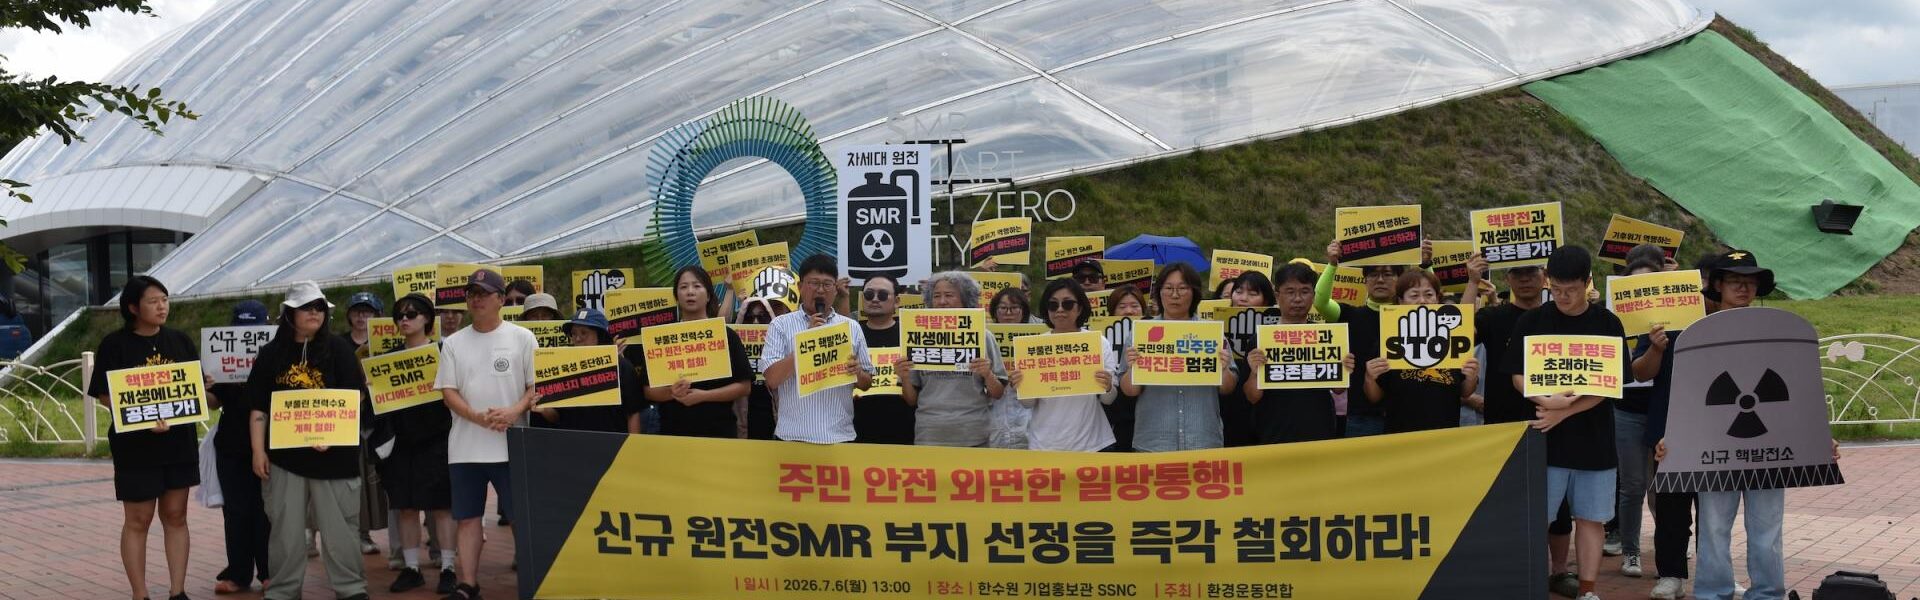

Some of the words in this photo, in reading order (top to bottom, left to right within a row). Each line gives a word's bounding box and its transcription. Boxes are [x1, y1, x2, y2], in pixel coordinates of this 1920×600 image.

[847, 151, 887, 167] 차세대
[892, 150, 919, 165] 원전
[972, 189, 1075, 223] ZERO
[856, 207, 901, 225] SMR
[1487, 209, 1546, 227] 핵발전과
[1343, 224, 1375, 236] 기후위기
[1377, 216, 1410, 229] 역행하는
[1480, 224, 1554, 244] 재생에너지
[1342, 239, 1376, 254] 원전확대
[1379, 231, 1417, 247] 중단하라!
[1612, 231, 1641, 241] 기후위기
[1643, 234, 1672, 245] 역행하는
[702, 246, 718, 257] 신규
[719, 238, 754, 252] 핵발전소
[1485, 241, 1553, 262] 공존불가!
[397, 273, 413, 284] 신규
[446, 276, 459, 285] 신규
[1614, 290, 1631, 301] 지역
[1633, 286, 1660, 298] 불평등
[1662, 283, 1698, 295] 초래하는
[610, 303, 637, 317] 기후위기
[639, 298, 669, 311] 역행하는
[1615, 300, 1654, 314] 핵발전소
[1656, 297, 1676, 308] 그만
[1677, 295, 1700, 307] 짓자!
[372, 324, 395, 336] 지역
[915, 315, 972, 330] 핵발전과
[209, 331, 237, 354] 신규
[654, 333, 678, 345] 부풀린
[680, 329, 714, 342] 전력수요
[800, 339, 816, 354] 신규
[818, 332, 848, 349] 핵발전소
[907, 331, 979, 346] 재생에너지
[1273, 329, 1333, 345] 핵발전과
[647, 348, 662, 359] 신규
[708, 339, 725, 351] 건설
[911, 347, 976, 364] 공존불가!
[1027, 346, 1053, 356] 부풀린
[1055, 343, 1089, 354] 전력수요
[1137, 343, 1175, 354] 국민의힘
[1176, 339, 1218, 354] 민주당
[1265, 346, 1341, 362] 재생에너지
[1385, 335, 1471, 360] STOP
[1531, 343, 1563, 356] 지역
[1568, 343, 1616, 359] 불평등
[370, 364, 391, 377] 신규
[393, 354, 436, 371] 핵발전소
[536, 364, 559, 378] 핵산업
[561, 361, 577, 373] 육성
[580, 355, 612, 370] 중단하고
[667, 359, 684, 370] 계획
[686, 357, 707, 368] 철회!
[813, 349, 838, 367] SMR
[1018, 359, 1036, 370] 신규
[1083, 354, 1101, 365] 건설
[1543, 358, 1604, 372] 초래하는
[125, 369, 186, 387] 핵발전과
[390, 370, 425, 387] SMR
[581, 371, 617, 388] 확대하라!
[800, 368, 828, 385] 어디에도
[1040, 372, 1058, 383] 계획
[1060, 371, 1081, 382] 철회!
[1269, 363, 1338, 381] 공존불가!
[119, 383, 197, 405] 재생에너지
[375, 386, 416, 404] 어디에도
[125, 400, 197, 423] 공존불가!
[284, 399, 310, 409] 부풀린
[312, 399, 346, 408] 전력수요
[273, 411, 291, 421] 신규
[339, 409, 356, 419] 건설
[295, 423, 311, 433] 계획
[314, 423, 335, 432] 철회!
[1701, 450, 1730, 465] 신규
[1735, 446, 1794, 463] 핵발전소
[779, 463, 851, 503] 주민
[864, 465, 937, 503] 안전
[950, 466, 1066, 503] 외면한
[1076, 459, 1244, 503] 일방통행!
[594, 510, 675, 557] 신규
[687, 514, 872, 560] 원전SMR
[885, 520, 969, 563] 부지
[984, 520, 1116, 564] 선정을
[1130, 519, 1221, 564] 즉각
[1232, 513, 1432, 563] 철회하라!
[743, 576, 769, 591] 일시
[784, 578, 868, 593] 2026.7.6(월)
[872, 579, 911, 593] 13:00
[936, 580, 964, 595] 장소
[978, 581, 1018, 597] 한수원
[1024, 582, 1095, 598] 기업홍보관
[1097, 583, 1137, 598] SSNC
[1165, 583, 1192, 599] 주최
[1207, 583, 1294, 599] 환경운동연합
